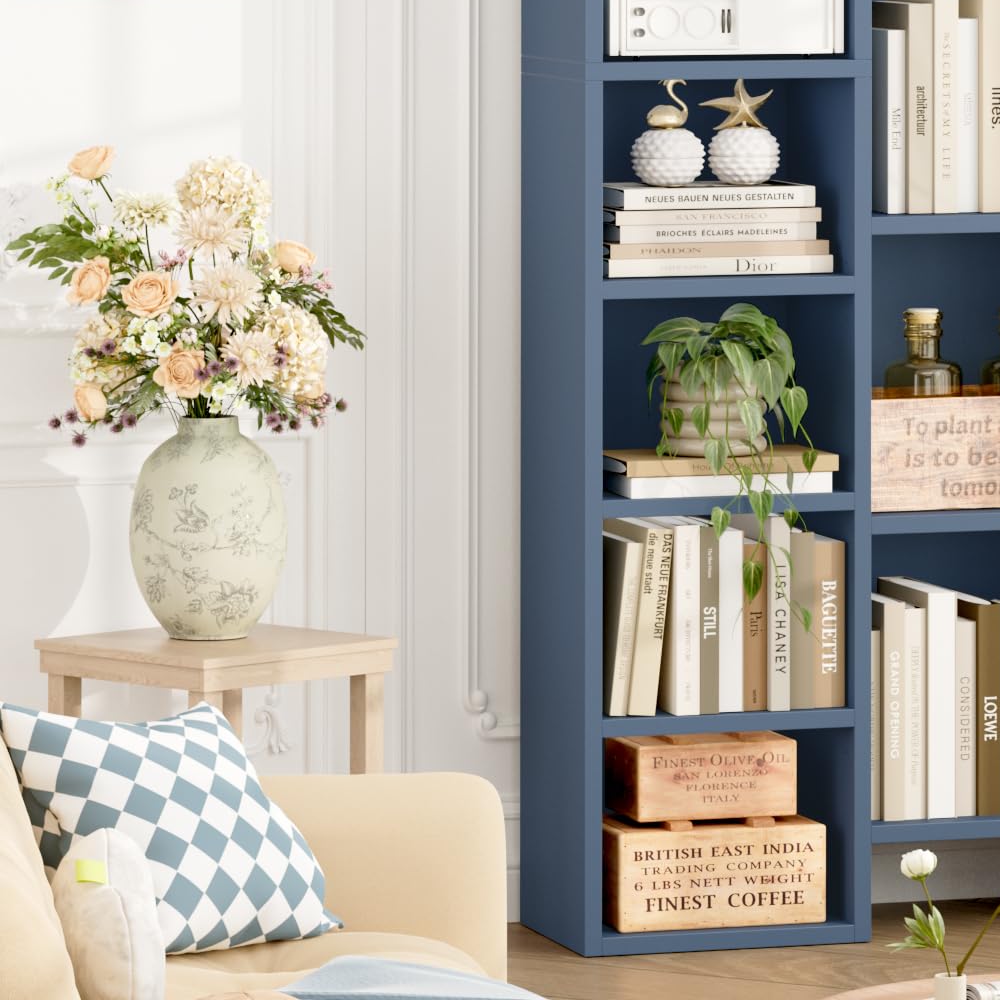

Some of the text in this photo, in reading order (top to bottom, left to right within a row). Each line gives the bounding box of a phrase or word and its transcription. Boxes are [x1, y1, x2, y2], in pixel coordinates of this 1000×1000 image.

[942, 44, 951, 108] SECRETS
[916, 86, 928, 136] architectuur
[942, 119, 951, 137] MY
[942, 147, 951, 180] LIFE
[644, 192, 794, 204] NEUES BAUEN NEUES GESTALTEN
[656, 229, 697, 238] BRIOCHES
[737, 227, 788, 236] MADELEINES
[640, 246, 702, 255] PHAIDON
[735, 258, 777, 273] Dior
[903, 417, 929, 436] To
[935, 415, 992, 438] plant
[904, 449, 924, 468] is
[932, 448, 959, 467] to
[643, 532, 658, 594] die neue stadt
[653, 533, 673, 640] DAS NEUE FRANKFURT
[703, 606, 717, 639] STILL
[749, 611, 763, 637] Paris
[775, 565, 786, 674] LISA CHANEY
[821, 580, 838, 674] BAGUETTE
[890, 651, 900, 759] GRAND OPENING
[960, 676, 970, 761] CONSIDERED
[983, 696, 998, 741] LOEWE
[673, 768, 768, 782] SAN LORENZO
[685, 781, 757, 792] FLORENCE
[702, 794, 740, 804] ITALY
[634, 841, 814, 862] BRITISH EAST INDIA
[641, 859, 807, 875] TRADING COMPANY
[634, 873, 815, 891] 6 LBS NETT WEIGHT
[645, 890, 804, 913] FINEST COFFEE
